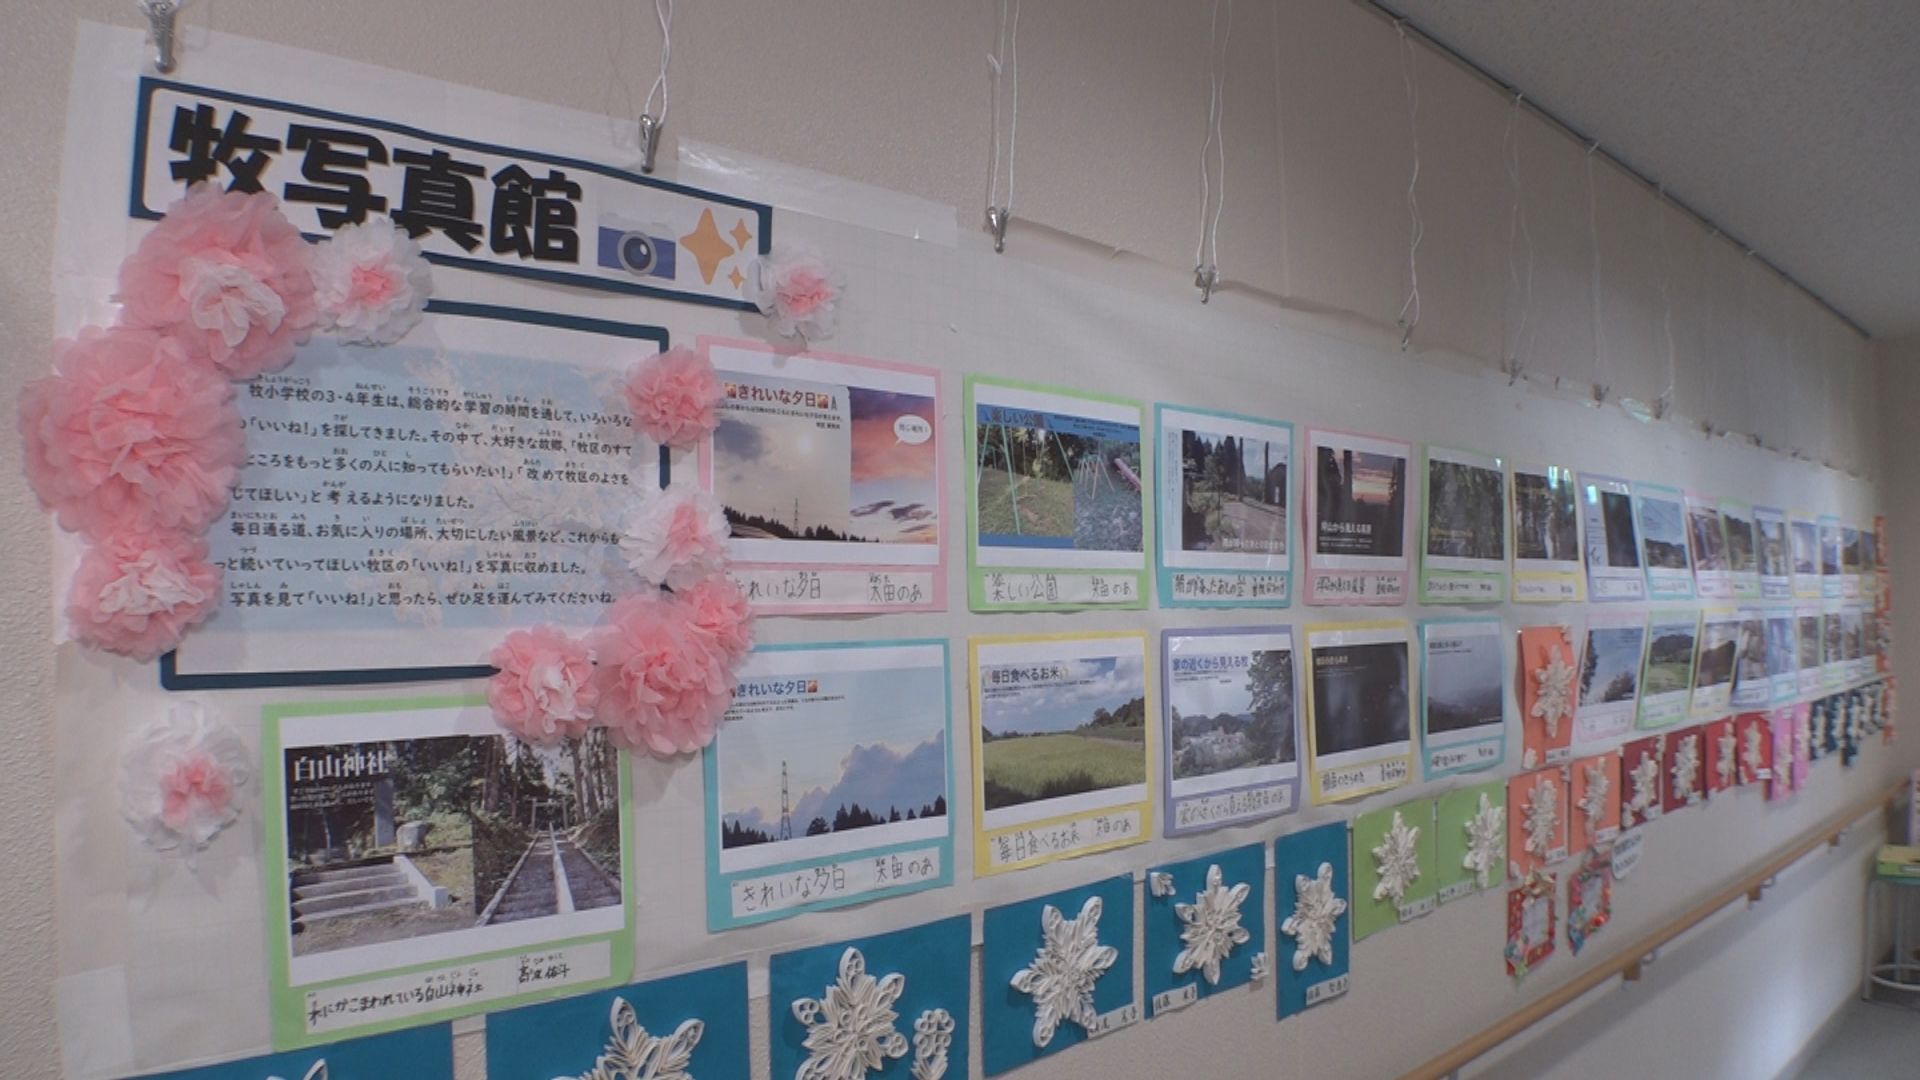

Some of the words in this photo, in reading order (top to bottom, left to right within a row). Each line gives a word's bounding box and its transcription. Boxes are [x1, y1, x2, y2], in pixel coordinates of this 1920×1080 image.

[168, 103, 583, 263] 牧写真館
[738, 384, 817, 408] きれいな夕日
[991, 667, 1060, 684] 毎日食べるお米
[737, 680, 807, 697] きれいな夕日
[294, 750, 390, 782] 白山神社
